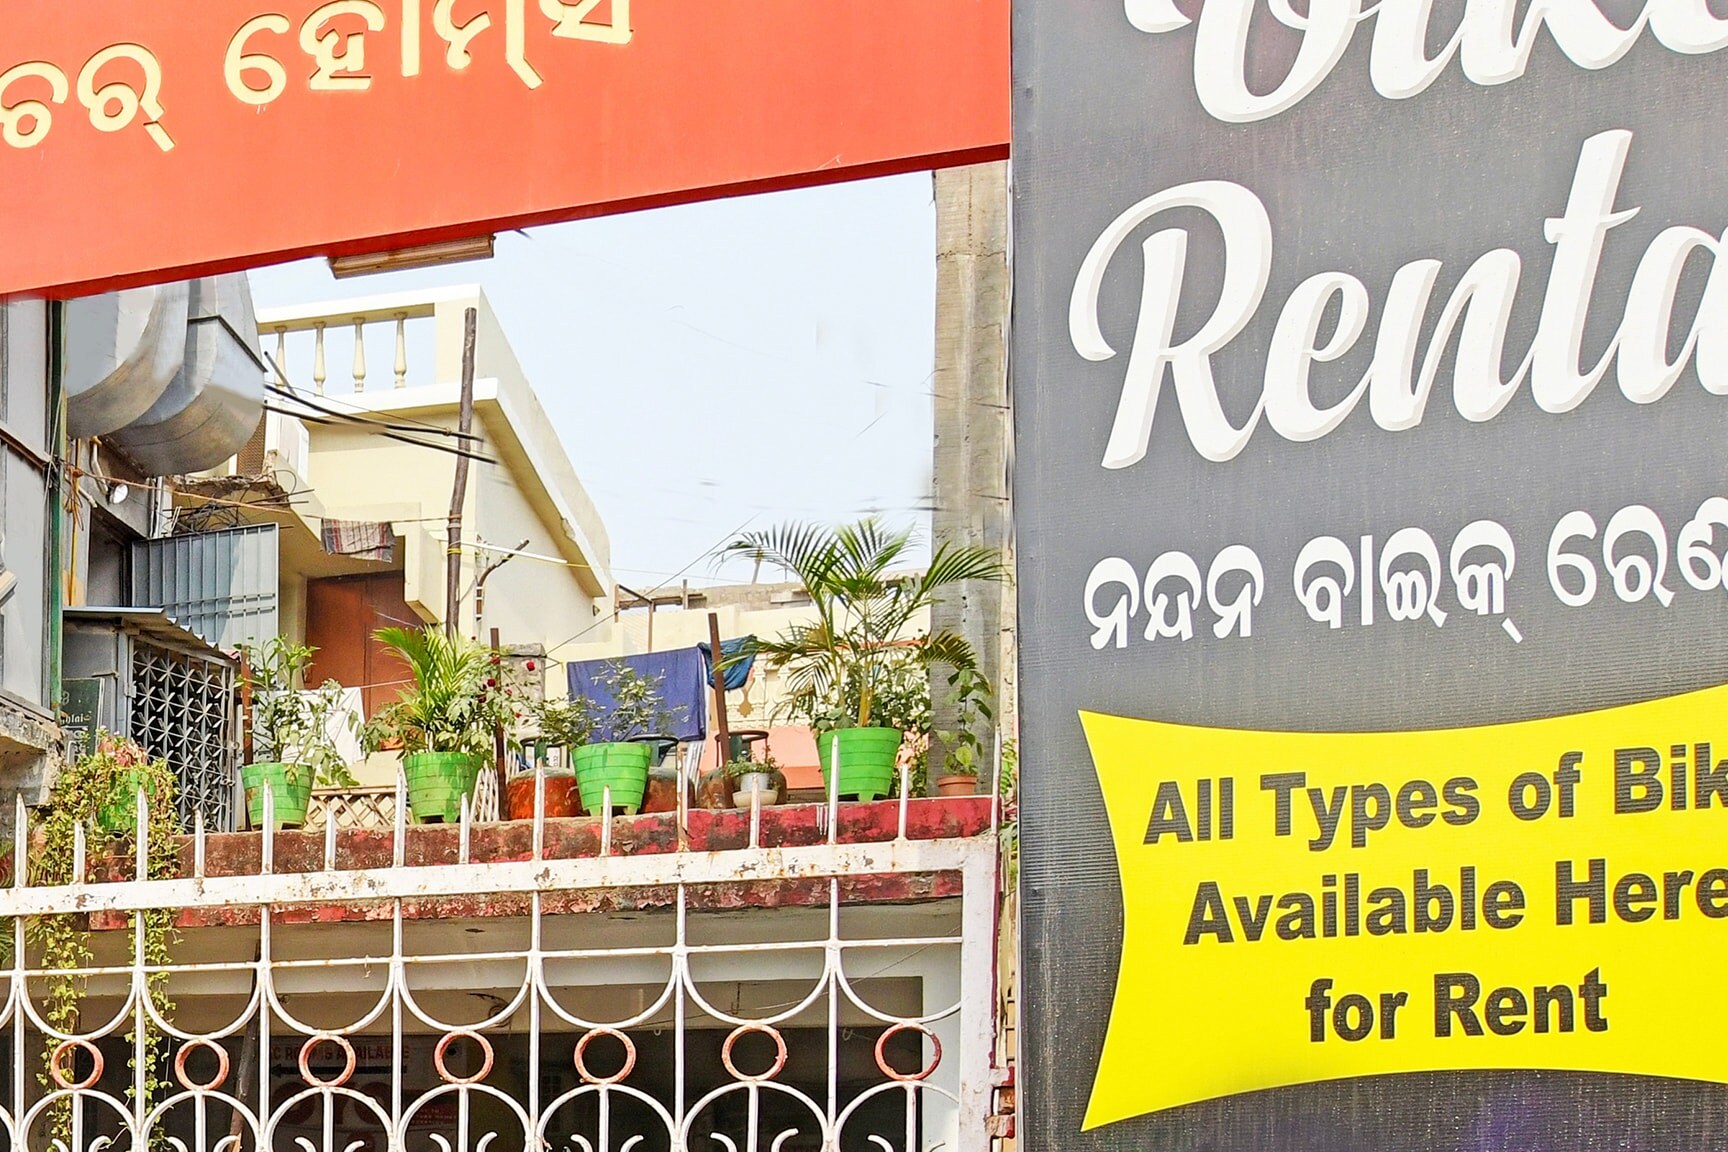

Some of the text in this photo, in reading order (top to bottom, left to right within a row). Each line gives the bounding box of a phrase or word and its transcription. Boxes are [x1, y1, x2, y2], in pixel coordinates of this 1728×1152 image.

[1143, 777, 1234, 846] All
[1260, 771, 1480, 853] Types
[1507, 751, 1583, 822] of
[1183, 857, 1728, 946] Available Here
[1305, 966, 1609, 1044] for Rent
